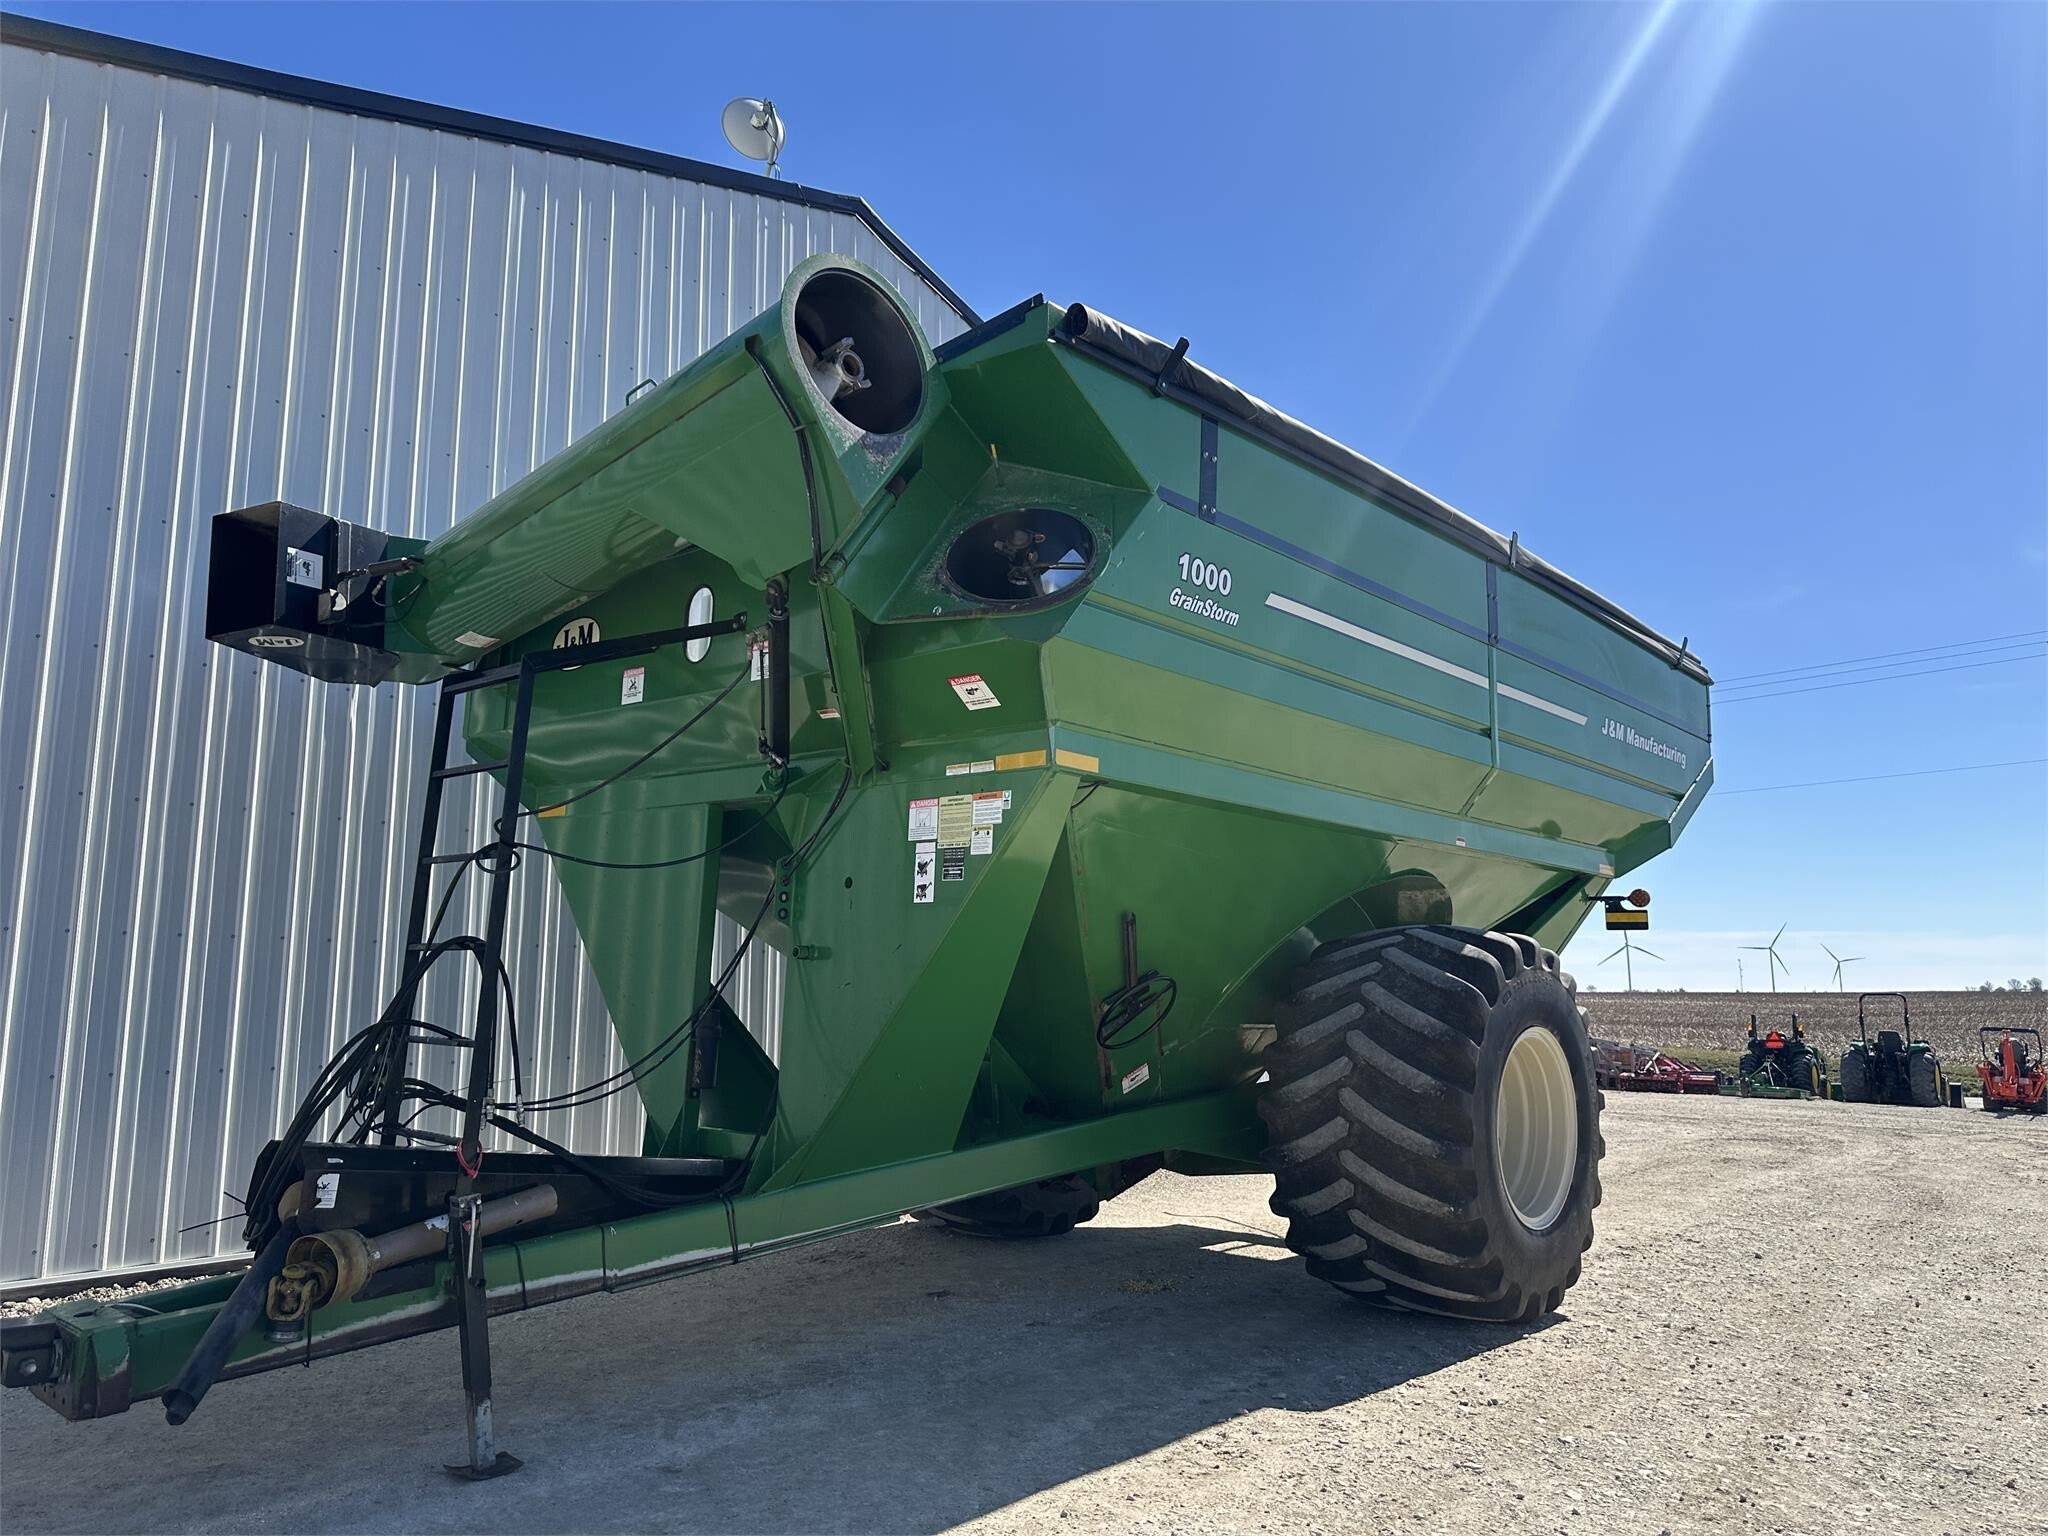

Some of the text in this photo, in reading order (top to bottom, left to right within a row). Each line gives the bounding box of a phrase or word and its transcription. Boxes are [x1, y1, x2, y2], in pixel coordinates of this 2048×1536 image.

[1178, 552, 1232, 596] 1000
[1169, 587, 1240, 626] GrainStorm
[1601, 718, 1687, 769] J&M Manufacturing
